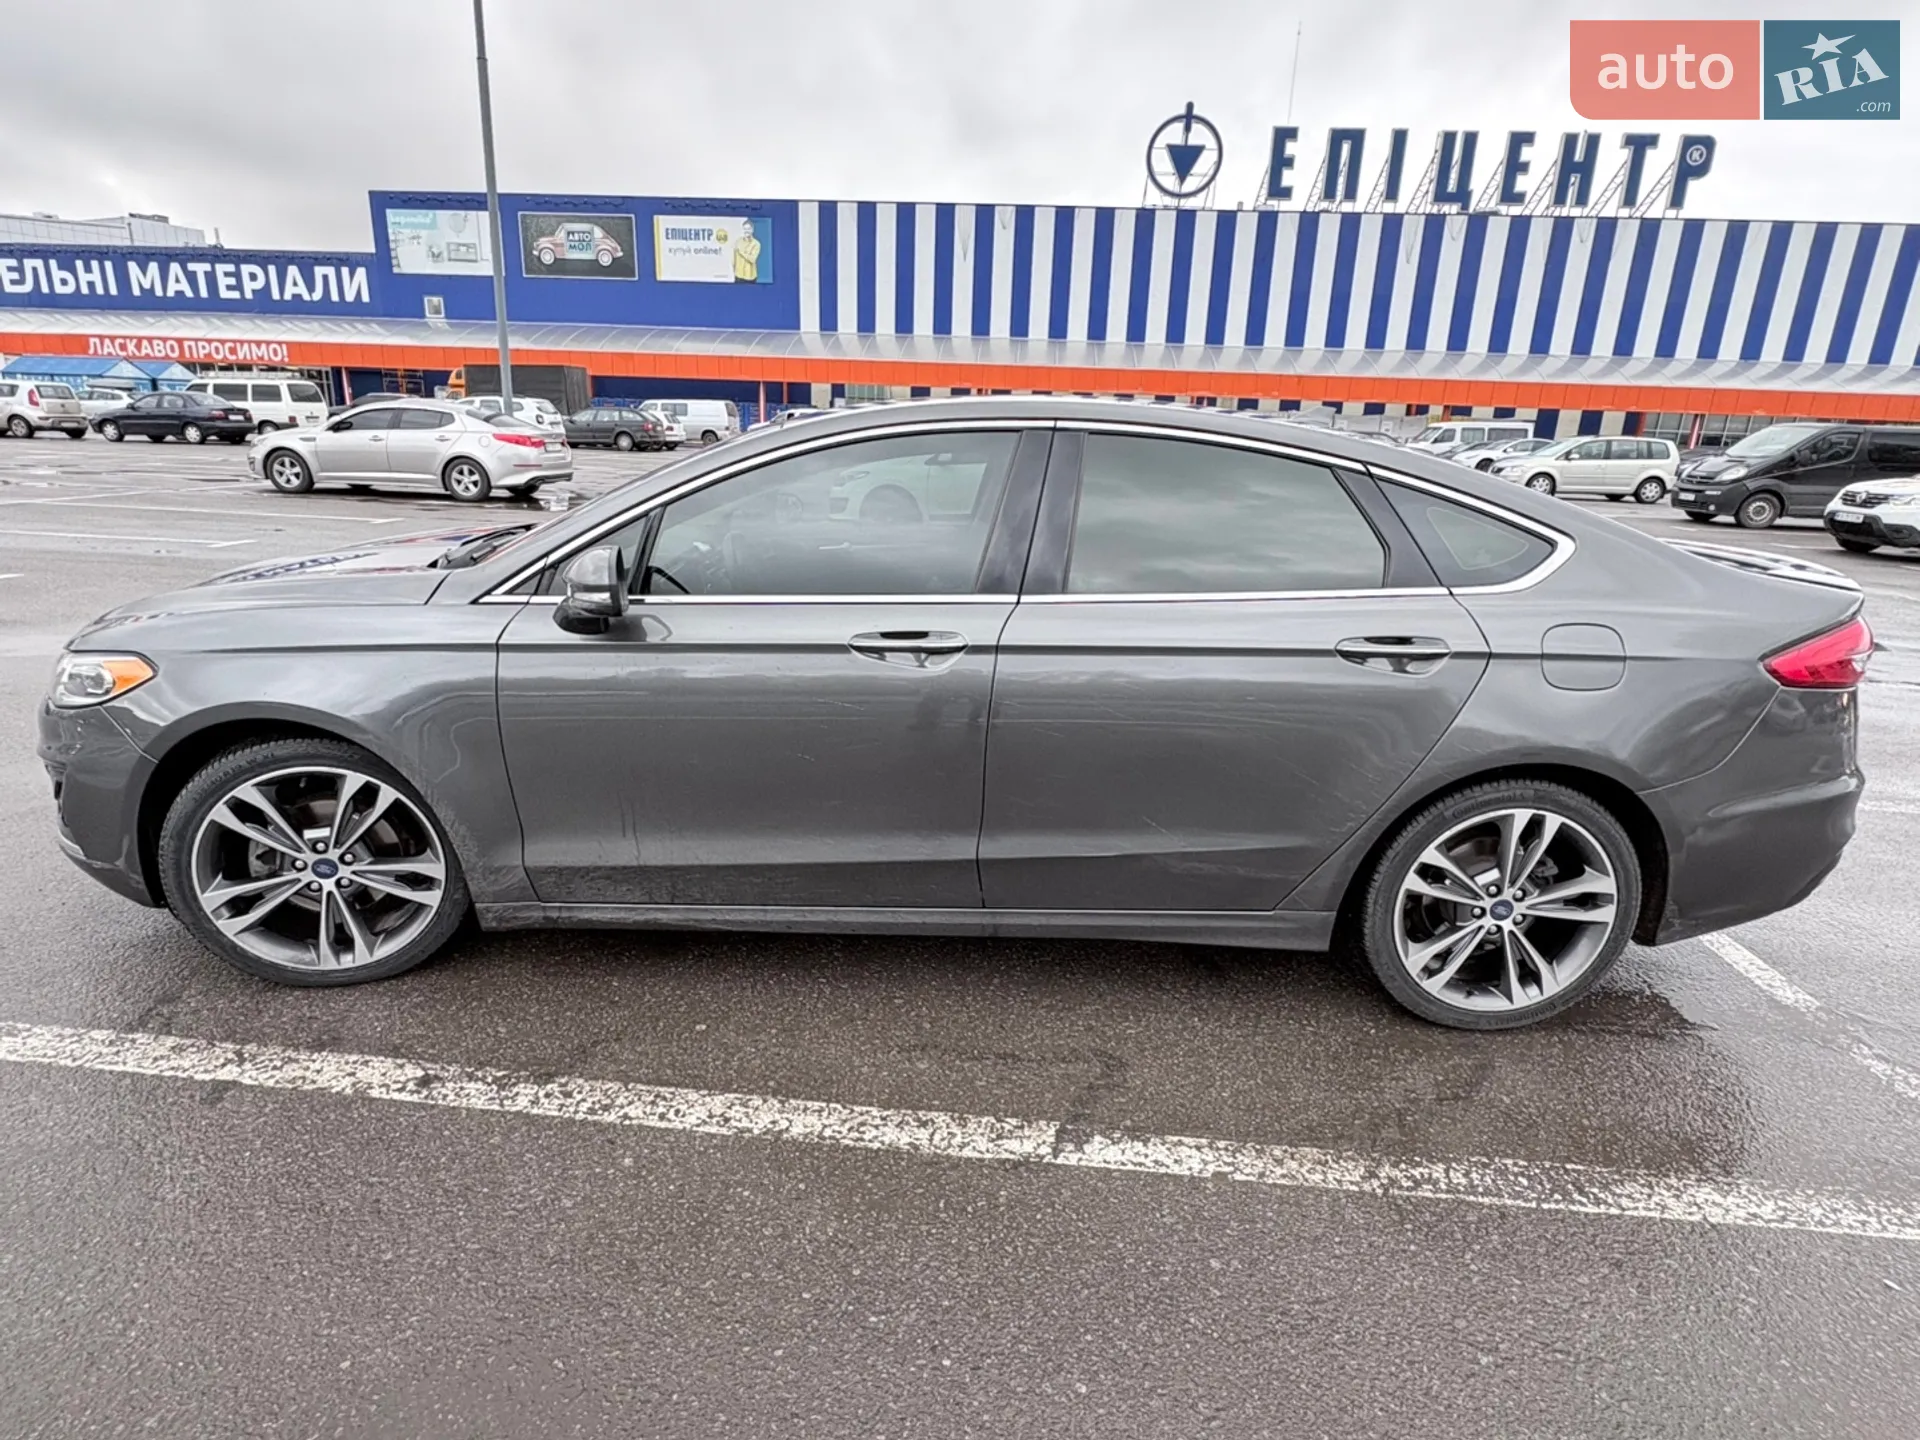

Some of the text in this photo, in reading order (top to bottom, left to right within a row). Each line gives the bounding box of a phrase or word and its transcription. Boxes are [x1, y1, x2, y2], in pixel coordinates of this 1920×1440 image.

[1266, 126, 1717, 211] ЕПІЦЕНТР
[568, 232, 591, 241] АВТО
[665, 227, 714, 241] ЕПІЦЕНТР
[127, 260, 371, 303] МАТЕРІАЛИ
[88, 336, 289, 363] ЛАСКАВО ПРОСИМО!
